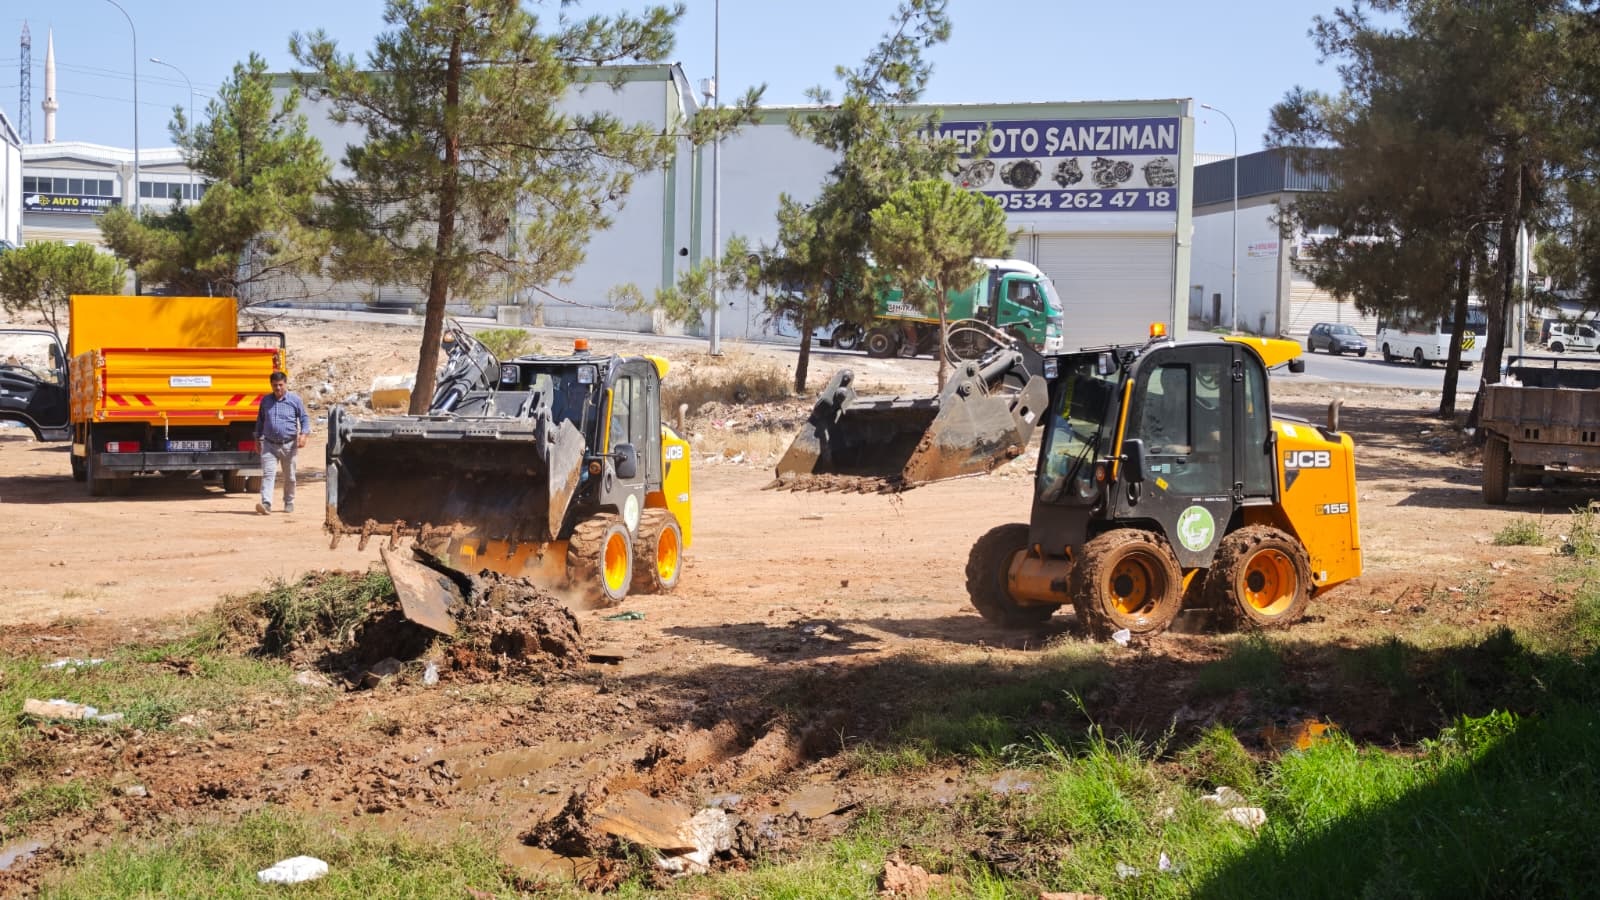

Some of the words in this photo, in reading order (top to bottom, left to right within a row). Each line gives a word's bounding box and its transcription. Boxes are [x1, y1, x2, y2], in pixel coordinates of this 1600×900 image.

[988, 127, 1039, 153] OTO
[1045, 124, 1175, 156] ŞANZIMAN
[52, 197, 80, 206] AUTO
[999, 193, 1052, 209] 0534
[1059, 192, 1103, 208] 262
[1109, 191, 1139, 208] 47
[1146, 191, 1170, 207] 18
[1284, 451, 1330, 468] JCB
[1323, 503, 1349, 514] 155
